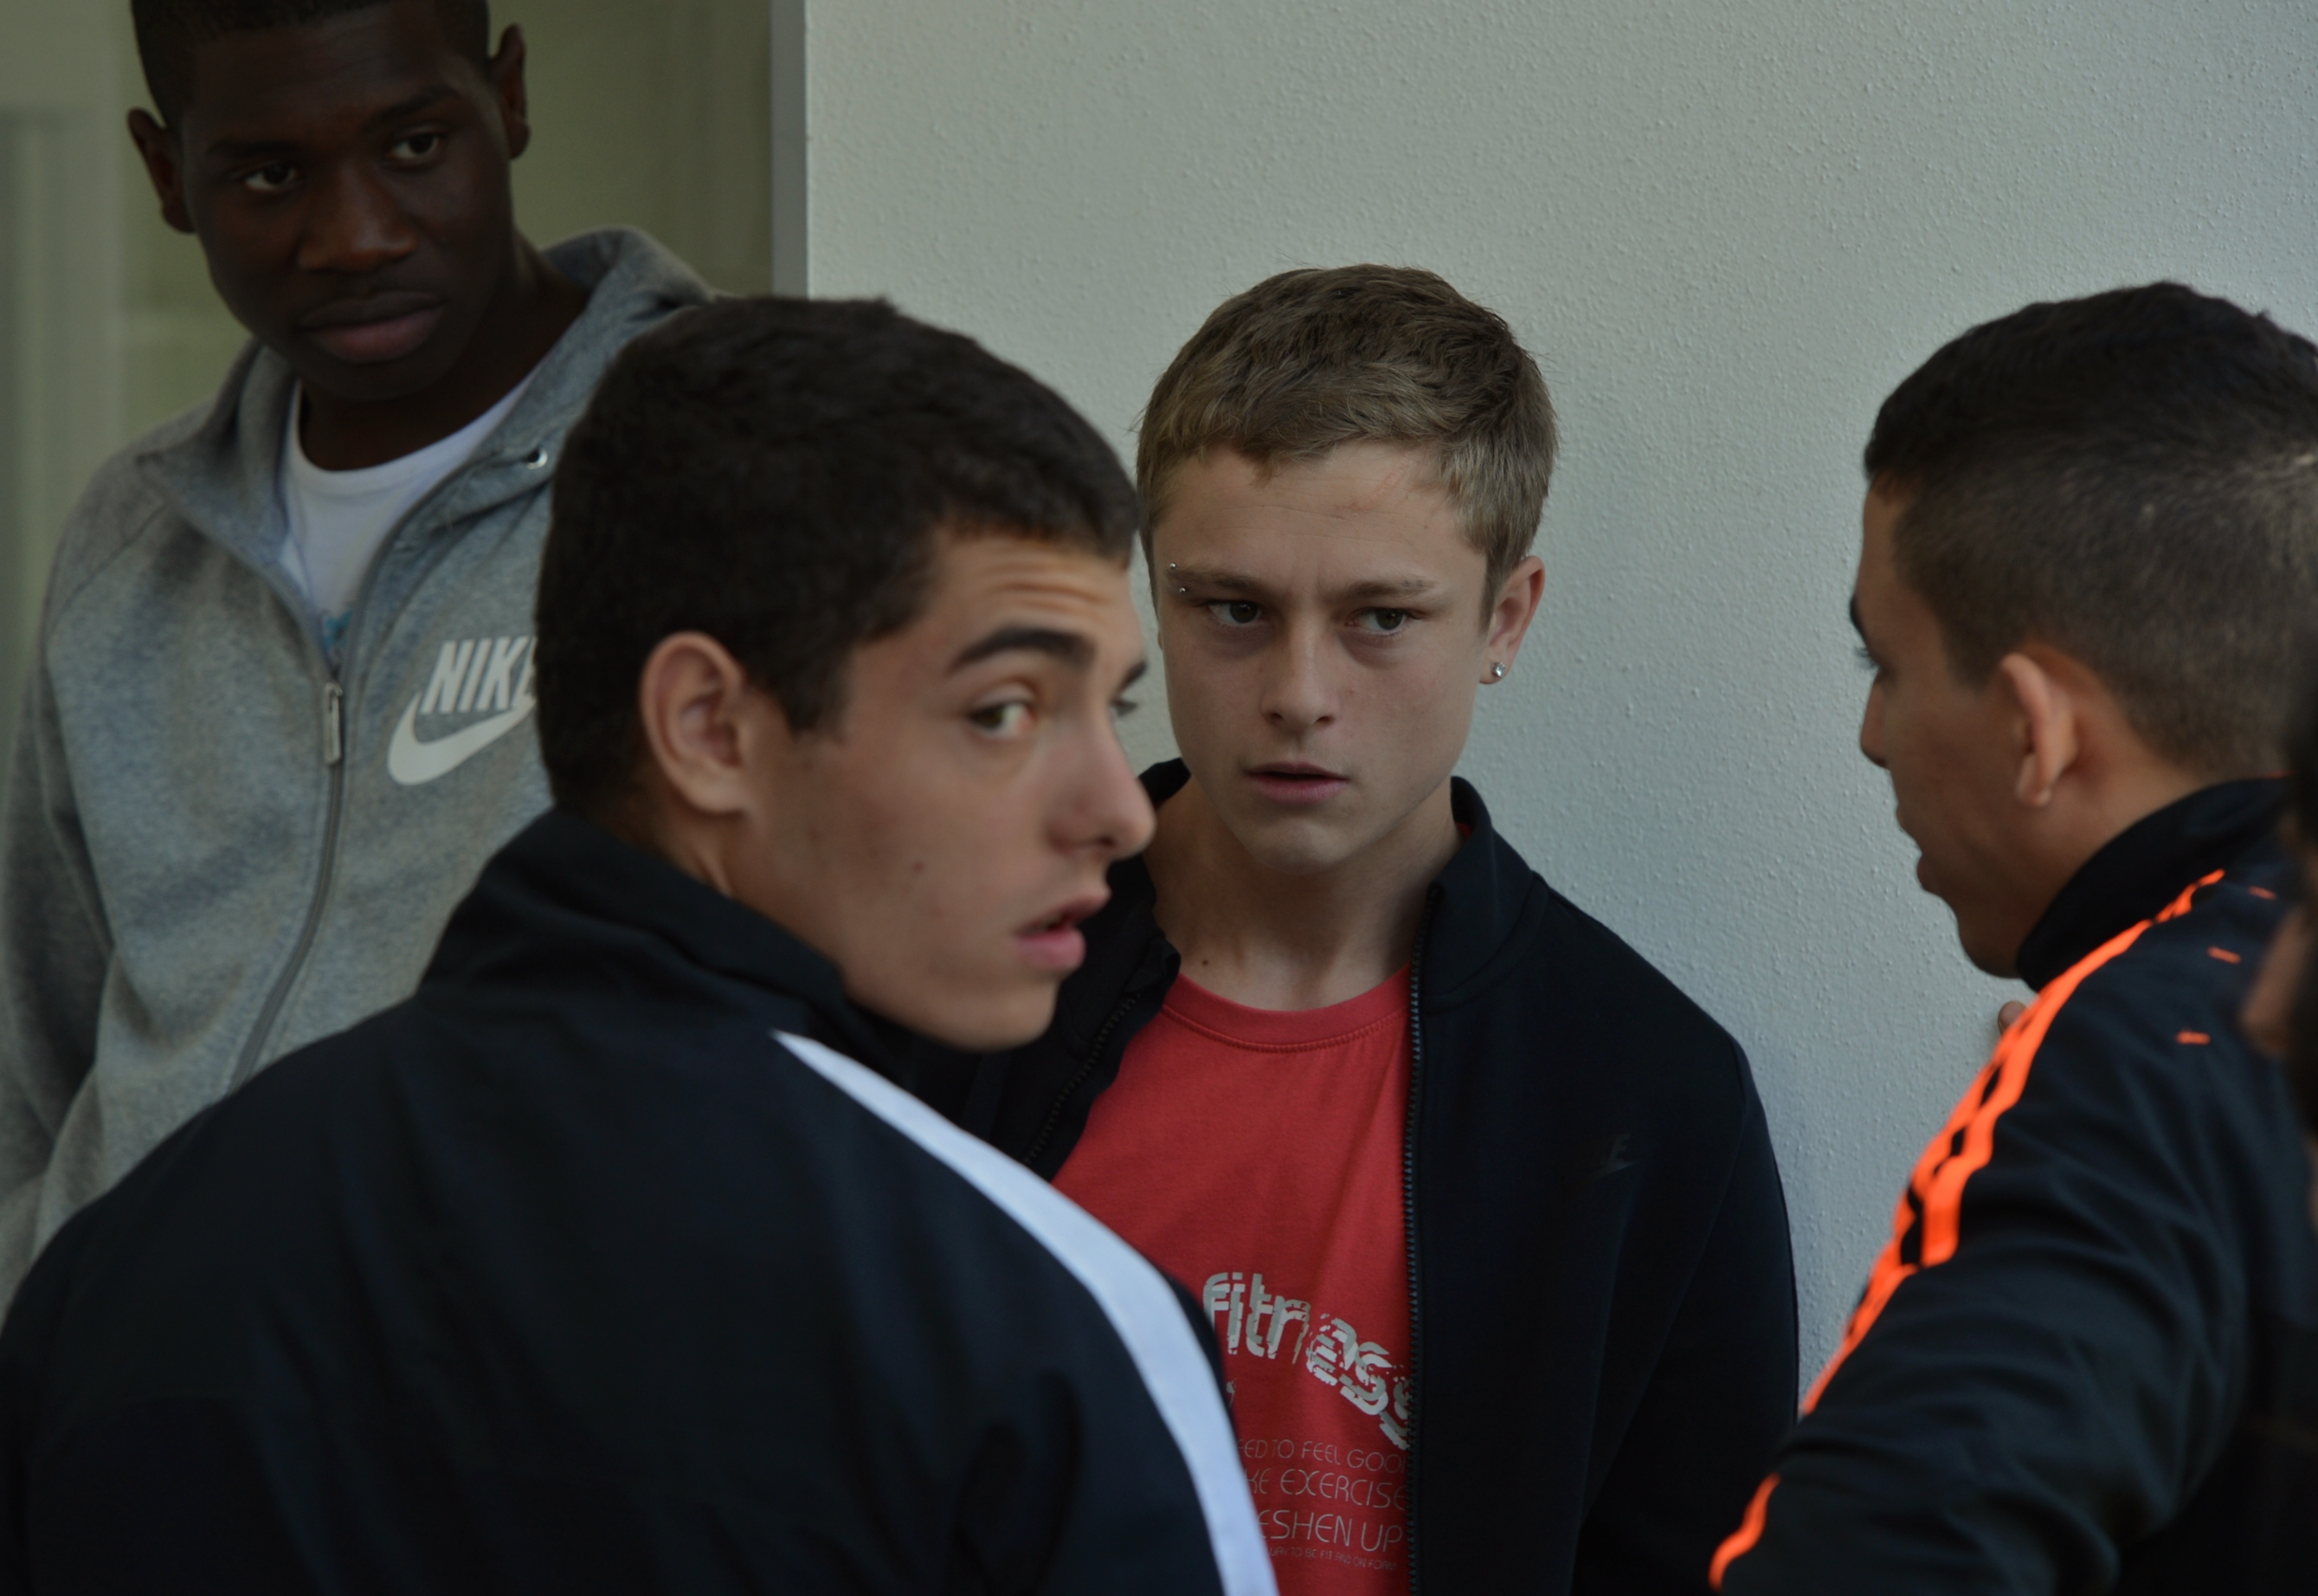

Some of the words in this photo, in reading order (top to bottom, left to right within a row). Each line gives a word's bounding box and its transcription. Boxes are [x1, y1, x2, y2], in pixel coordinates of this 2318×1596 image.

[1271, 1439, 1295, 1459] TO
[1301, 1440, 1341, 1465] FEEL
[1280, 1469, 1409, 1511] EXERCISE
[1361, 1522, 1403, 1553] UP
